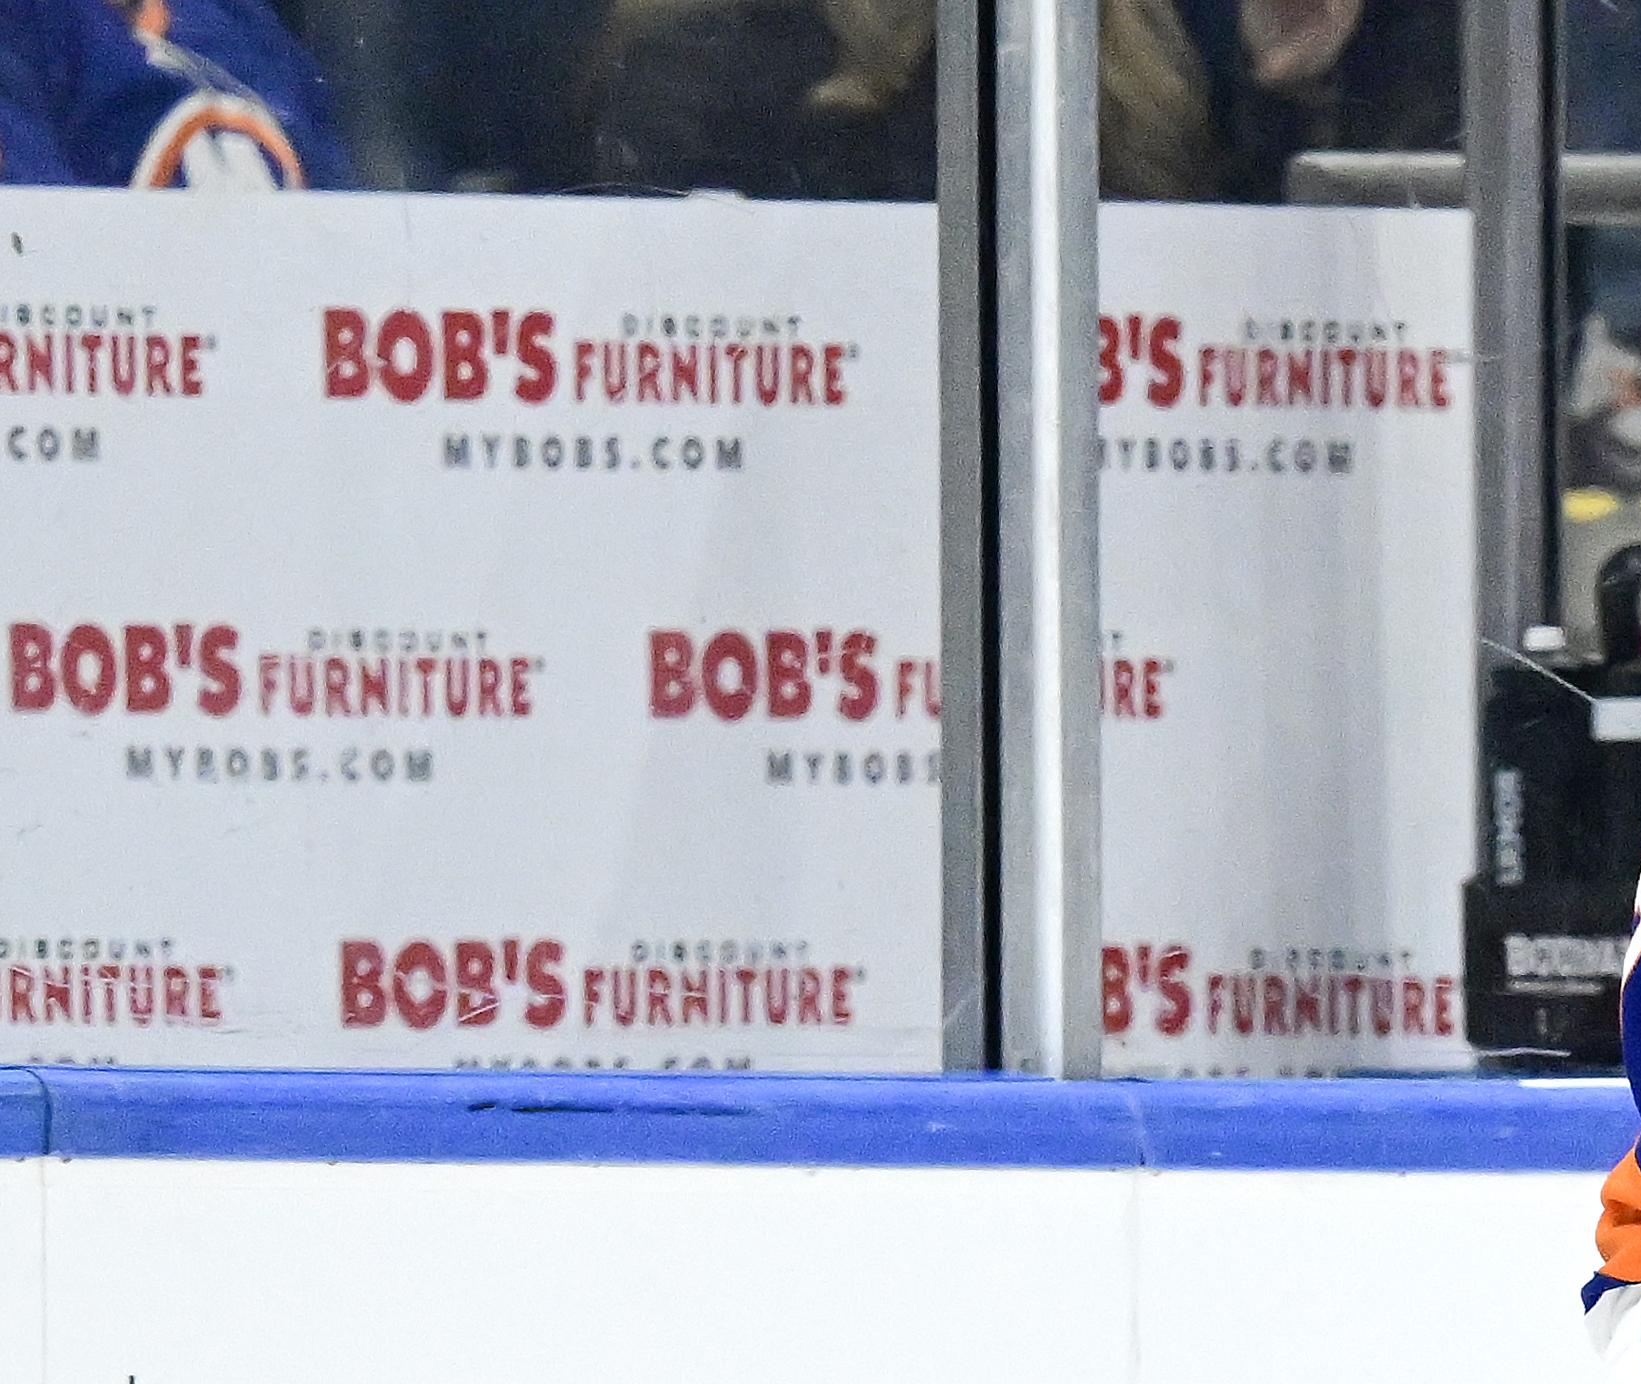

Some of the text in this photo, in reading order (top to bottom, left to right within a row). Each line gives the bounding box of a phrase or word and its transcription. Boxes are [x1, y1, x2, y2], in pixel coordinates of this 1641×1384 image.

[323, 307, 846, 405] BOB'S FURNITURE
[1199, 347, 1450, 408] FURNITURE
[443, 434, 745, 469] MYBOBS.COM
[9, 623, 533, 717] BOB'S FURNITURE
[649, 630, 878, 721] BOB'S
[126, 747, 434, 781] MYBOBS.COM
[341, 939, 852, 1028] BOB'S FURNITURE
[1208, 974, 1453, 1037] FURNITURE
